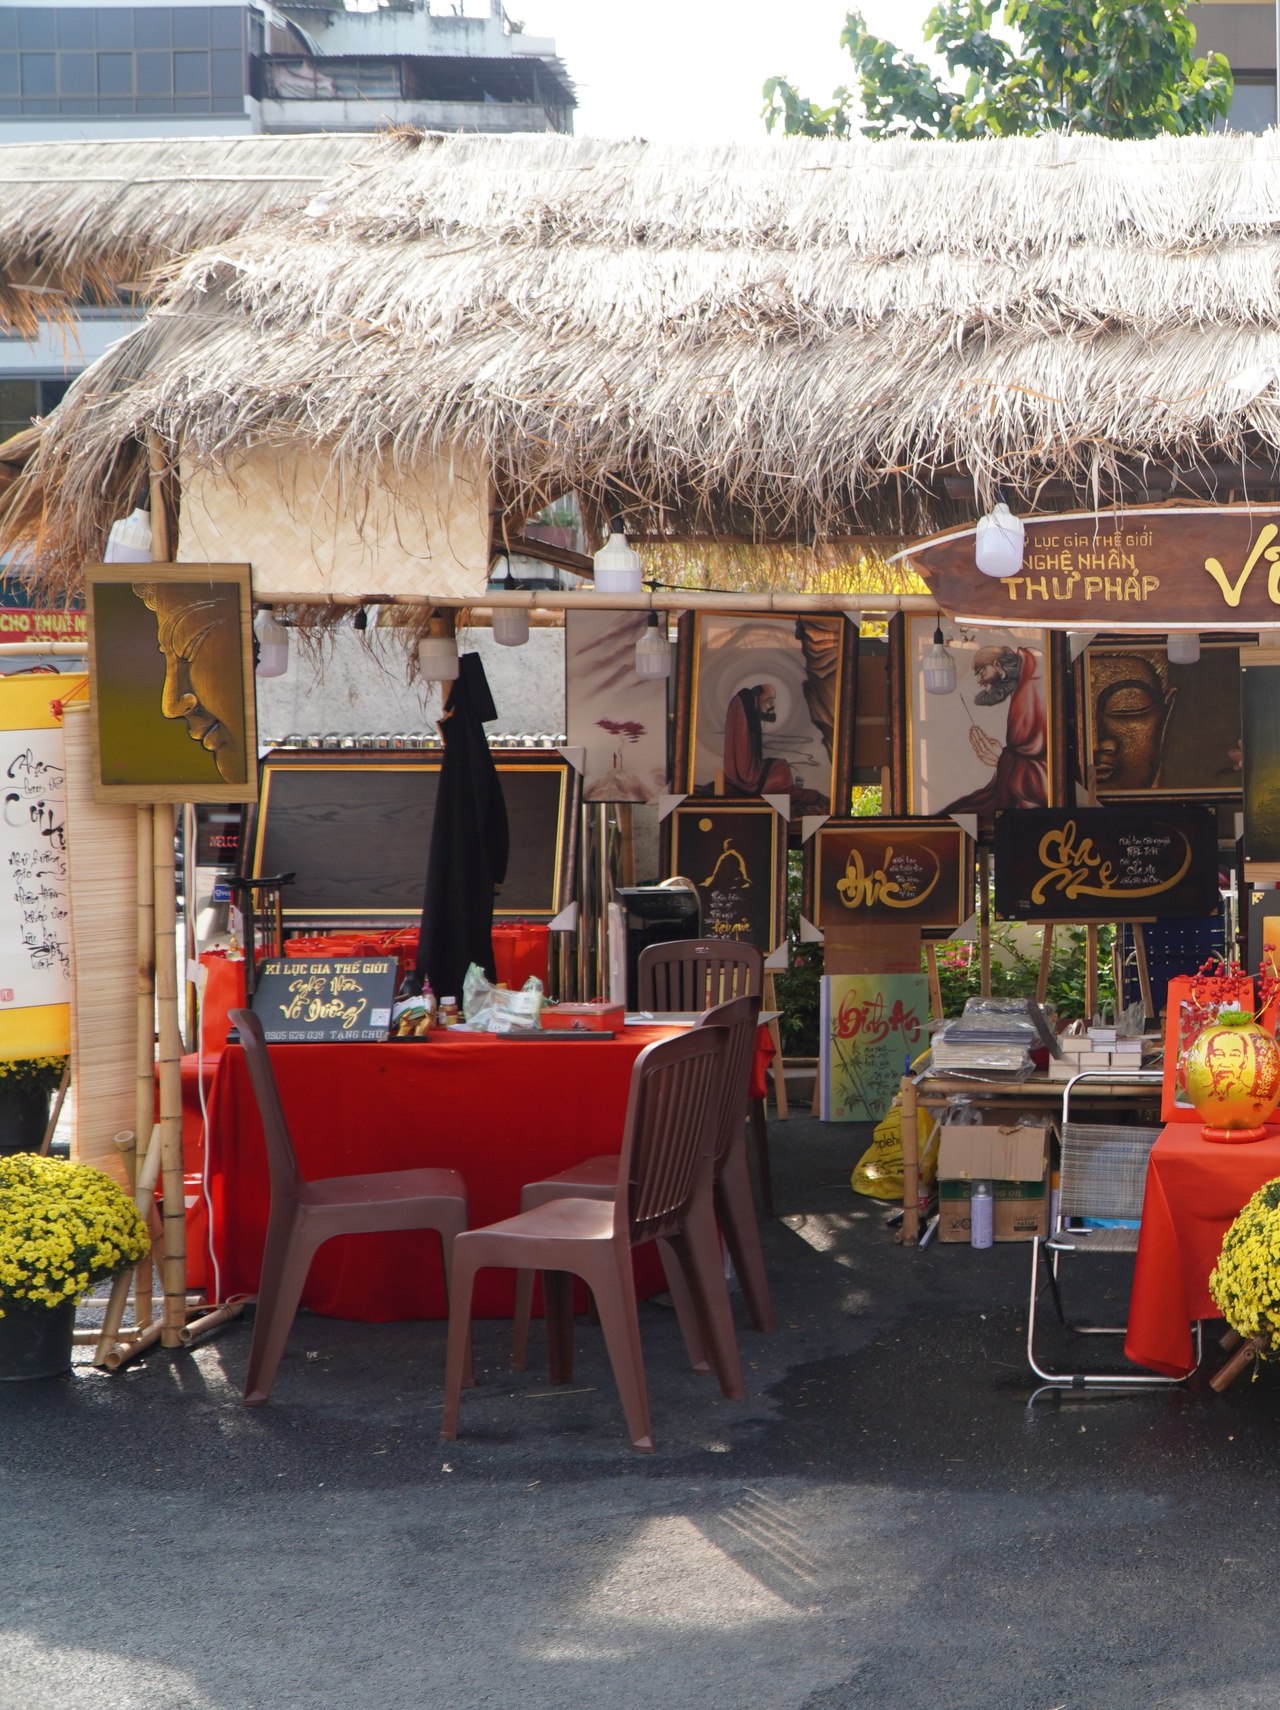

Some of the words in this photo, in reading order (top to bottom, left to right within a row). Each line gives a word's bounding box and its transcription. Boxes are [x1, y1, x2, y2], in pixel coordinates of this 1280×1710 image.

[1034, 536, 1059, 550] LỤC
[1021, 549, 1073, 574] NGHỆ
[1078, 549, 1135, 570] NHÂN
[1000, 571, 1082, 600] THƯ
[1083, 568, 1160, 601] PHÁP
[0, 614, 30, 632] CHO
[1038, 819, 1101, 869] Cha
[283, 964, 307, 976] LỤC
[309, 964, 331, 975] GIA
[334, 960, 362, 974] THẾ
[362, 962, 389, 974] GIỚI
[279, 994, 310, 1019] Võ
[264, 1031, 287, 1041] 0905
[288, 1031, 305, 1040] 676
[306, 1031, 324, 1040] 039
[1007, 1189, 1023, 1198] OIL
